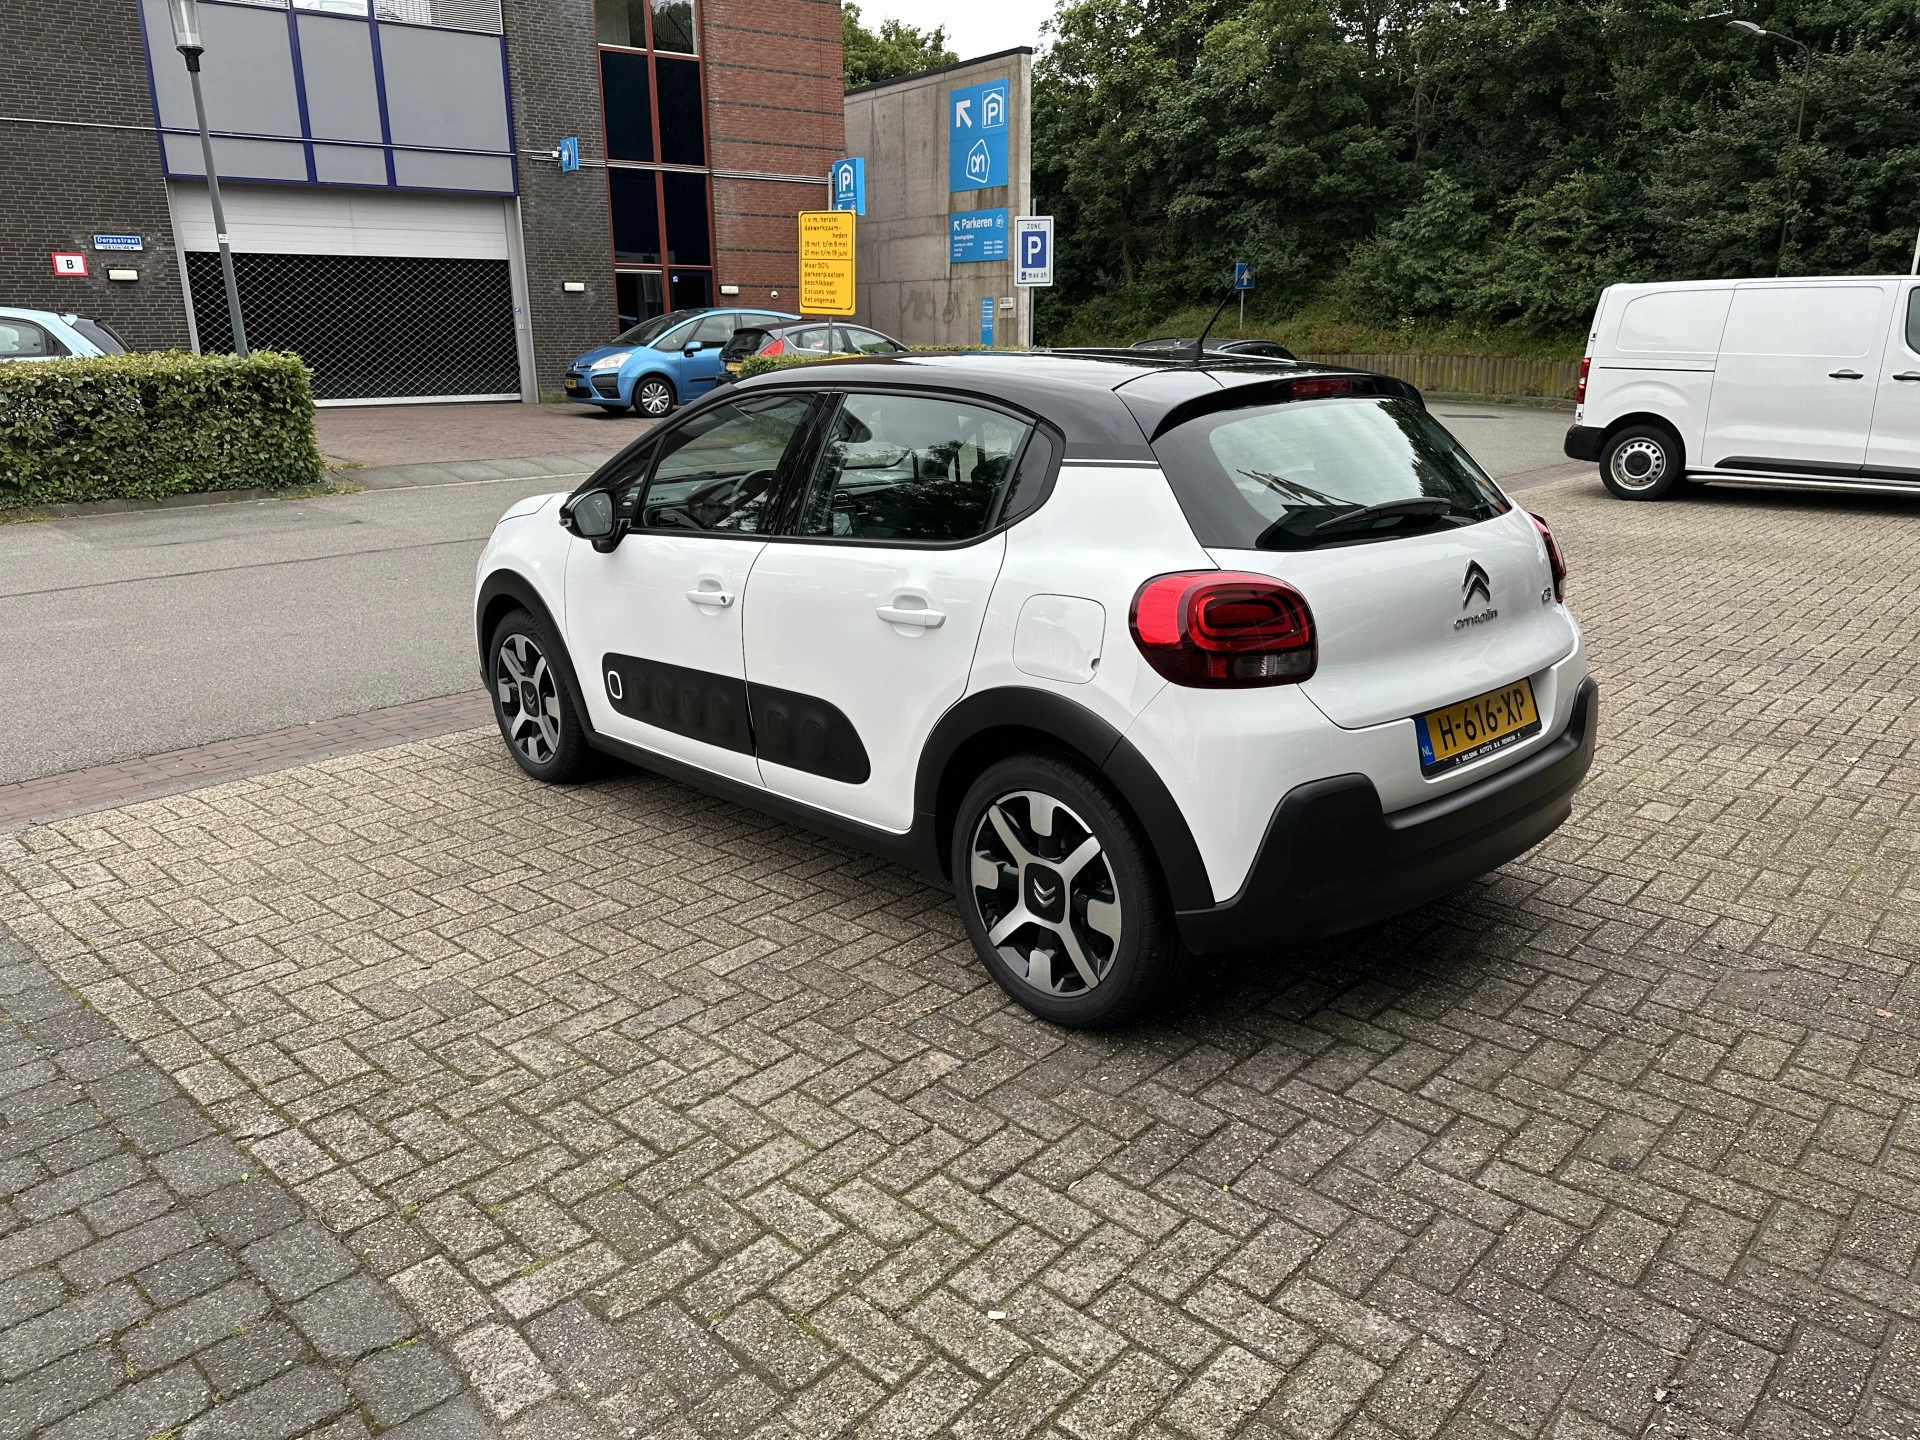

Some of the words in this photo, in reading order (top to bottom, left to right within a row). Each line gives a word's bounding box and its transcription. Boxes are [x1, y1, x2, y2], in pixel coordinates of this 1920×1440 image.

[961, 216, 993, 230] Parkeren
[97, 237, 139, 245] Dorpsstraat
[822, 240, 833, 248] t/m
[820, 249, 832, 257] t/m
[838, 249, 848, 258] juni
[1027, 235, 1042, 265] P
[66, 260, 74, 269] B
[1040, 271, 1048, 279] 2h
[1437, 688, 1525, 750] H-616-XP
[1421, 744, 1433, 757] NL
